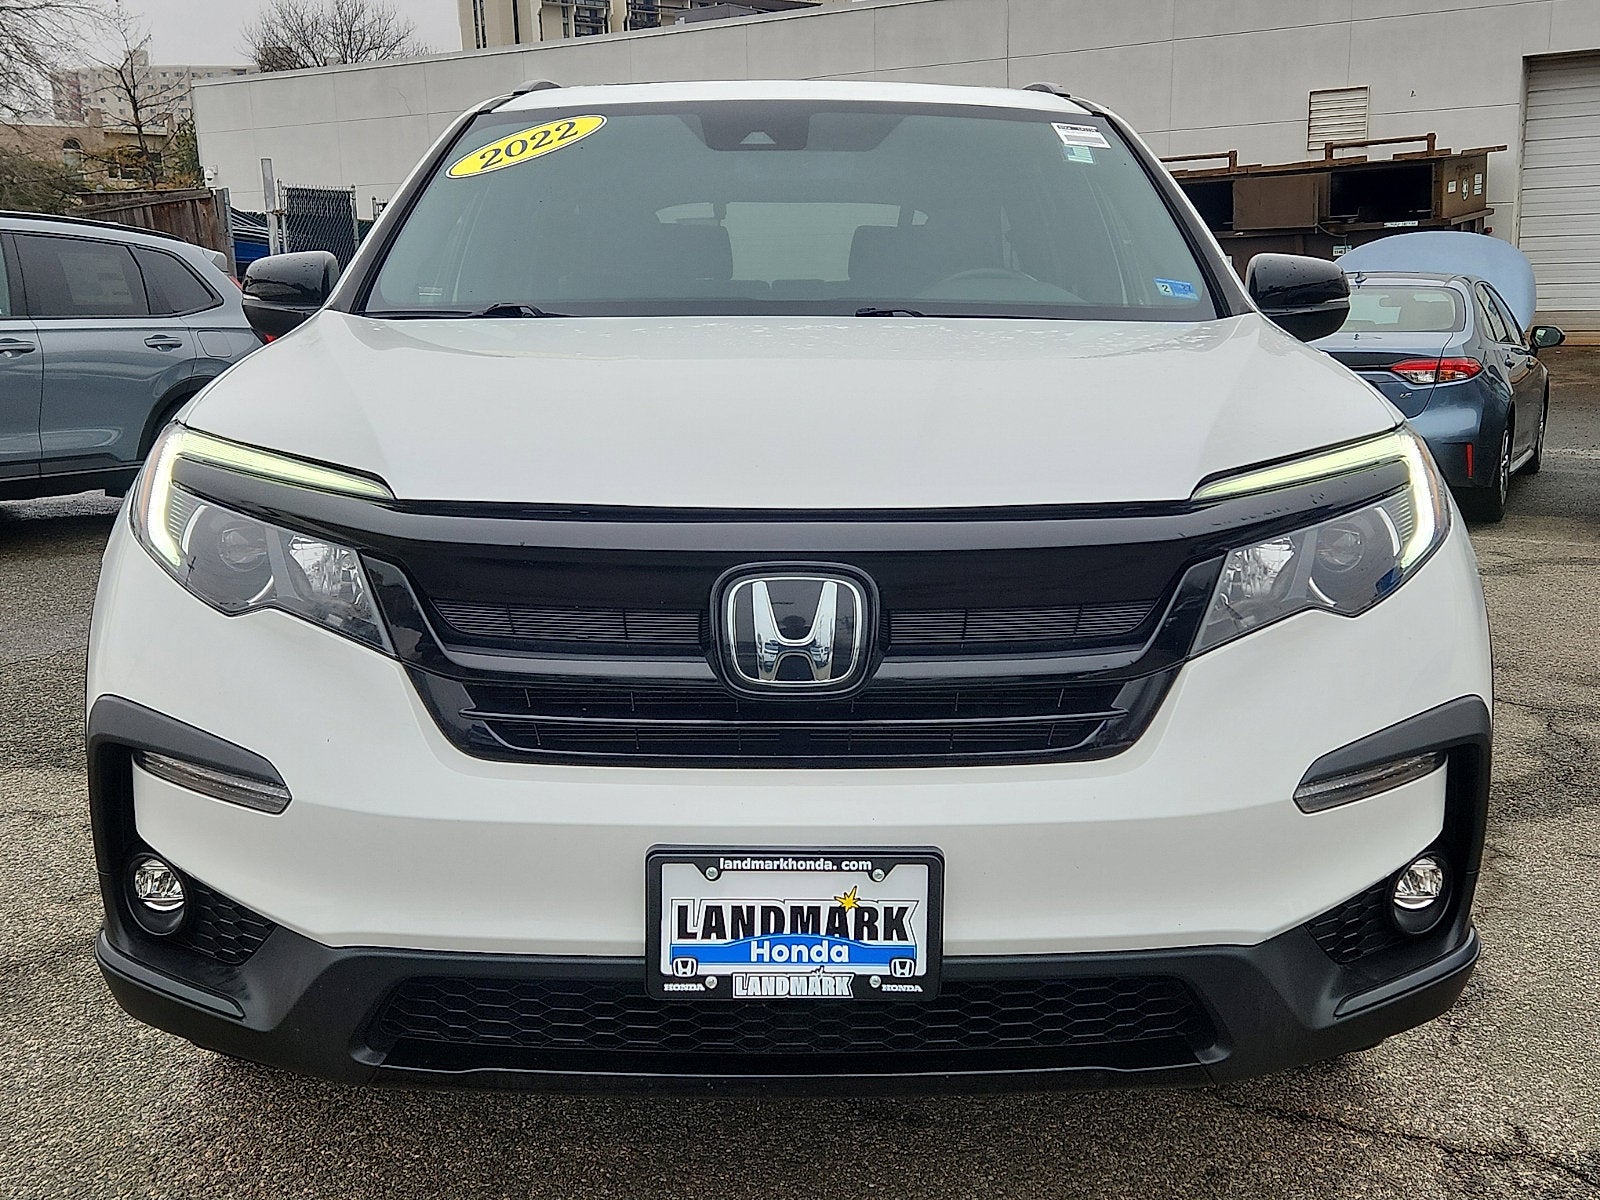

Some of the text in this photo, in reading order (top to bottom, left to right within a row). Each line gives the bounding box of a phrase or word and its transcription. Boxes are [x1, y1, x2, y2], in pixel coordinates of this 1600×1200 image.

[480, 121, 578, 169] 2022
[1162, 284, 1170, 293] 2
[677, 905, 909, 941] LANDMARK
[750, 940, 850, 963] Honda
[663, 983, 706, 992] HONDA
[735, 976, 851, 996] LANDMARK
[882, 984, 924, 993] HONDA
